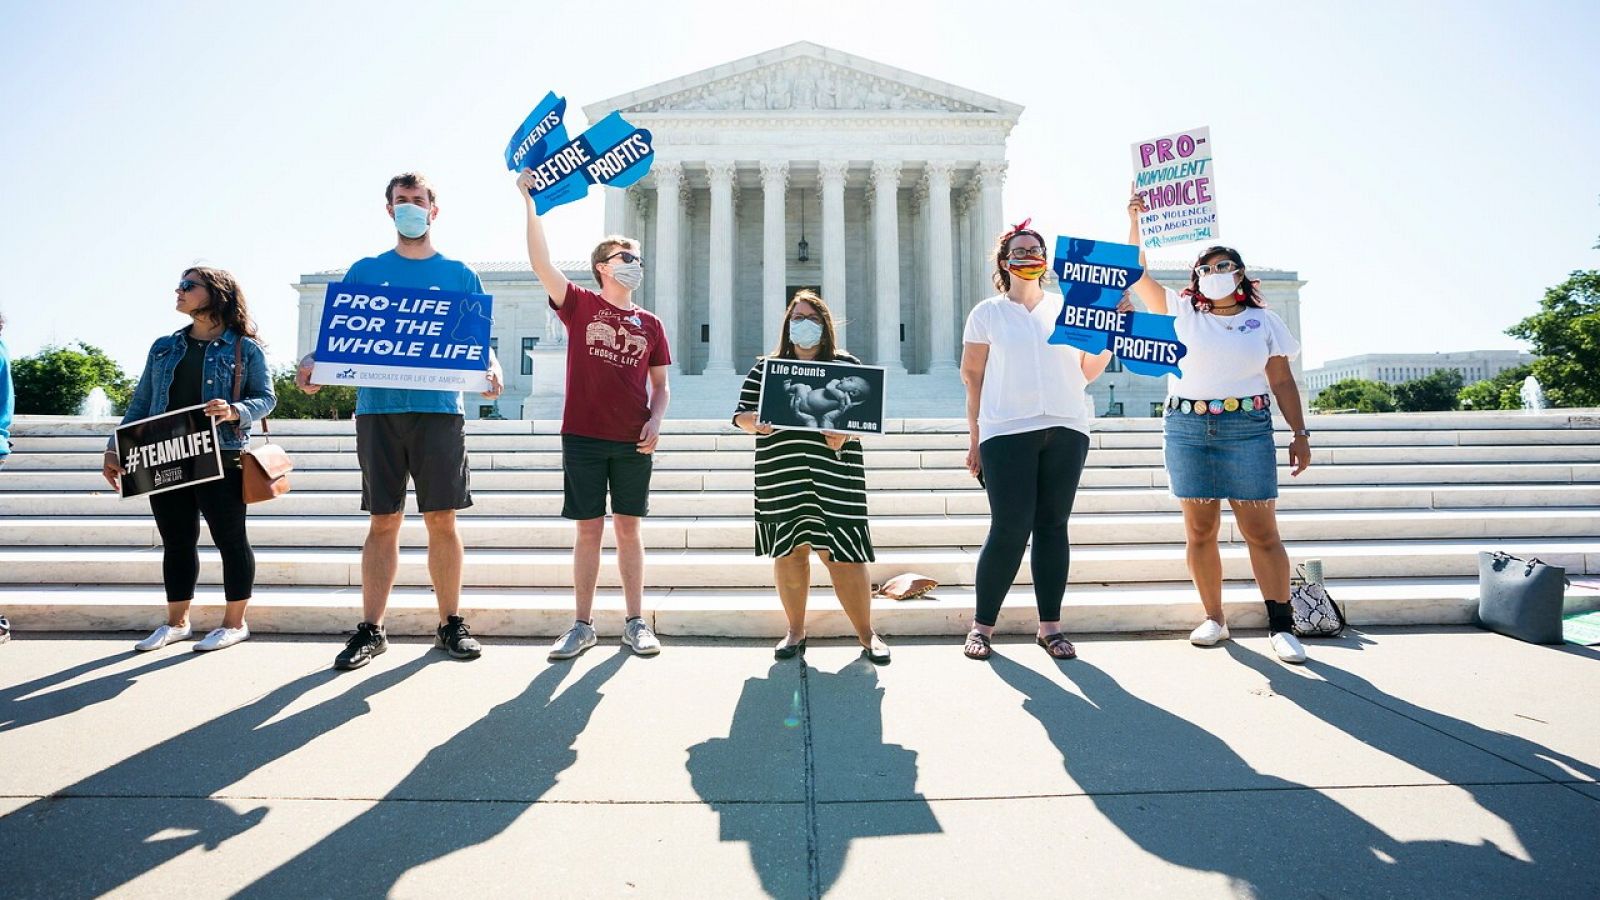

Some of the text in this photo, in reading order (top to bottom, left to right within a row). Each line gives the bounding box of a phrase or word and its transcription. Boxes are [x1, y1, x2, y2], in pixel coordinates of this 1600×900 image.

[512, 111, 560, 166] PATIENTS
[1140, 134, 1205, 168] PRO-
[531, 141, 591, 191] BEFORE
[586, 134, 650, 184] PROFITS
[1136, 157, 1212, 187] NONVIOLENT
[1139, 177, 1212, 213] CHOICE
[1141, 214, 1159, 224] END
[1164, 214, 1216, 231] ABORTION!
[1063, 262, 1128, 288] PATIENTS
[332, 293, 451, 316] PRO-LIFE
[329, 314, 444, 336] FOR THE
[1064, 305, 1127, 333] BEFORE
[327, 336, 483, 361] WHOLE LIFE
[589, 347, 619, 361] CHOOSE
[621, 355, 640, 367] LIFE
[1113, 335, 1178, 364] PROFITS
[360, 372, 466, 384] DEMOCRATS FOR LIFE OF AMERICA
[771, 364, 826, 377] Life Counts
[847, 420, 877, 431] AUL.ORG
[124, 429, 213, 474] #TEAMLIFE
